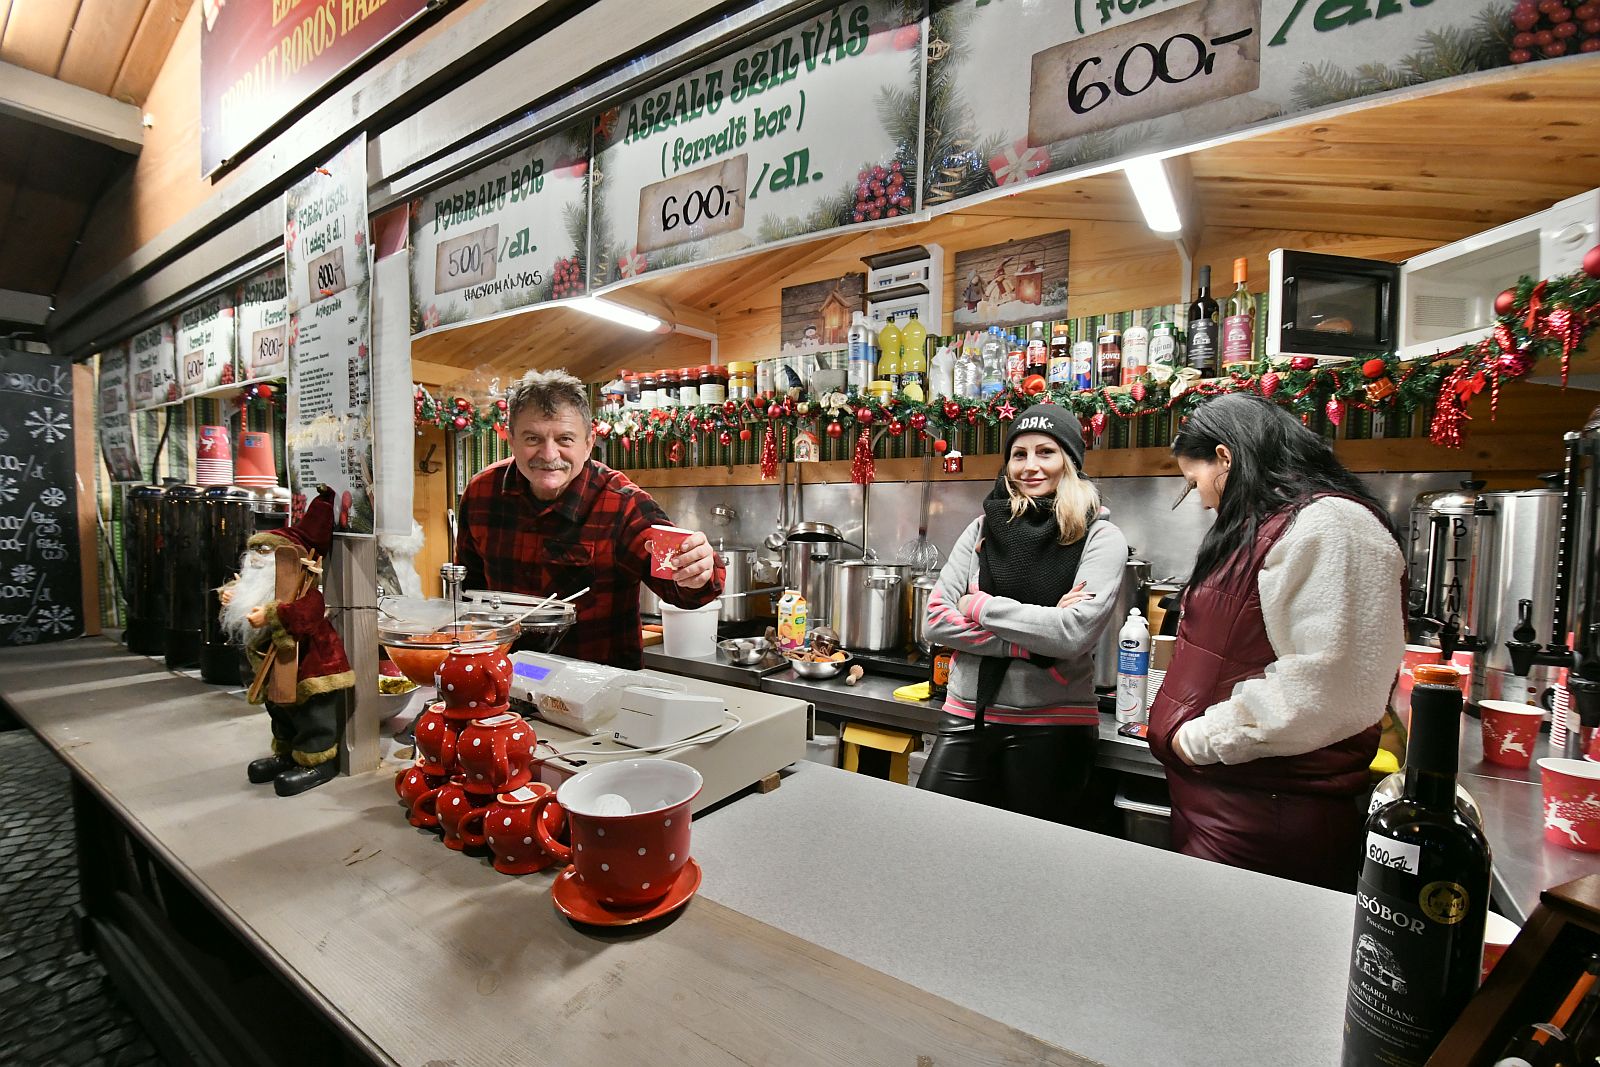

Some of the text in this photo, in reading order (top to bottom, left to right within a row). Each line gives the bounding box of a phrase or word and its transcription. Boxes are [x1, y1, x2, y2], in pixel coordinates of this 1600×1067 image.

[282, 0, 336, 80] BOROS
[624, 4, 870, 145] ASZALT SZILVÁS
[1067, 27, 1253, 115] 600,-
[434, 158, 544, 235] FORRALT BOR
[749, 146, 824, 200] /dl.
[310, 231, 326, 253] adag
[497, 227, 537, 263] /dl.
[464, 270, 543, 302] HAGYOMÁNYOS
[1357, 890, 1426, 936] CSÓBOR
[1381, 1002, 1417, 1024] FRANC
